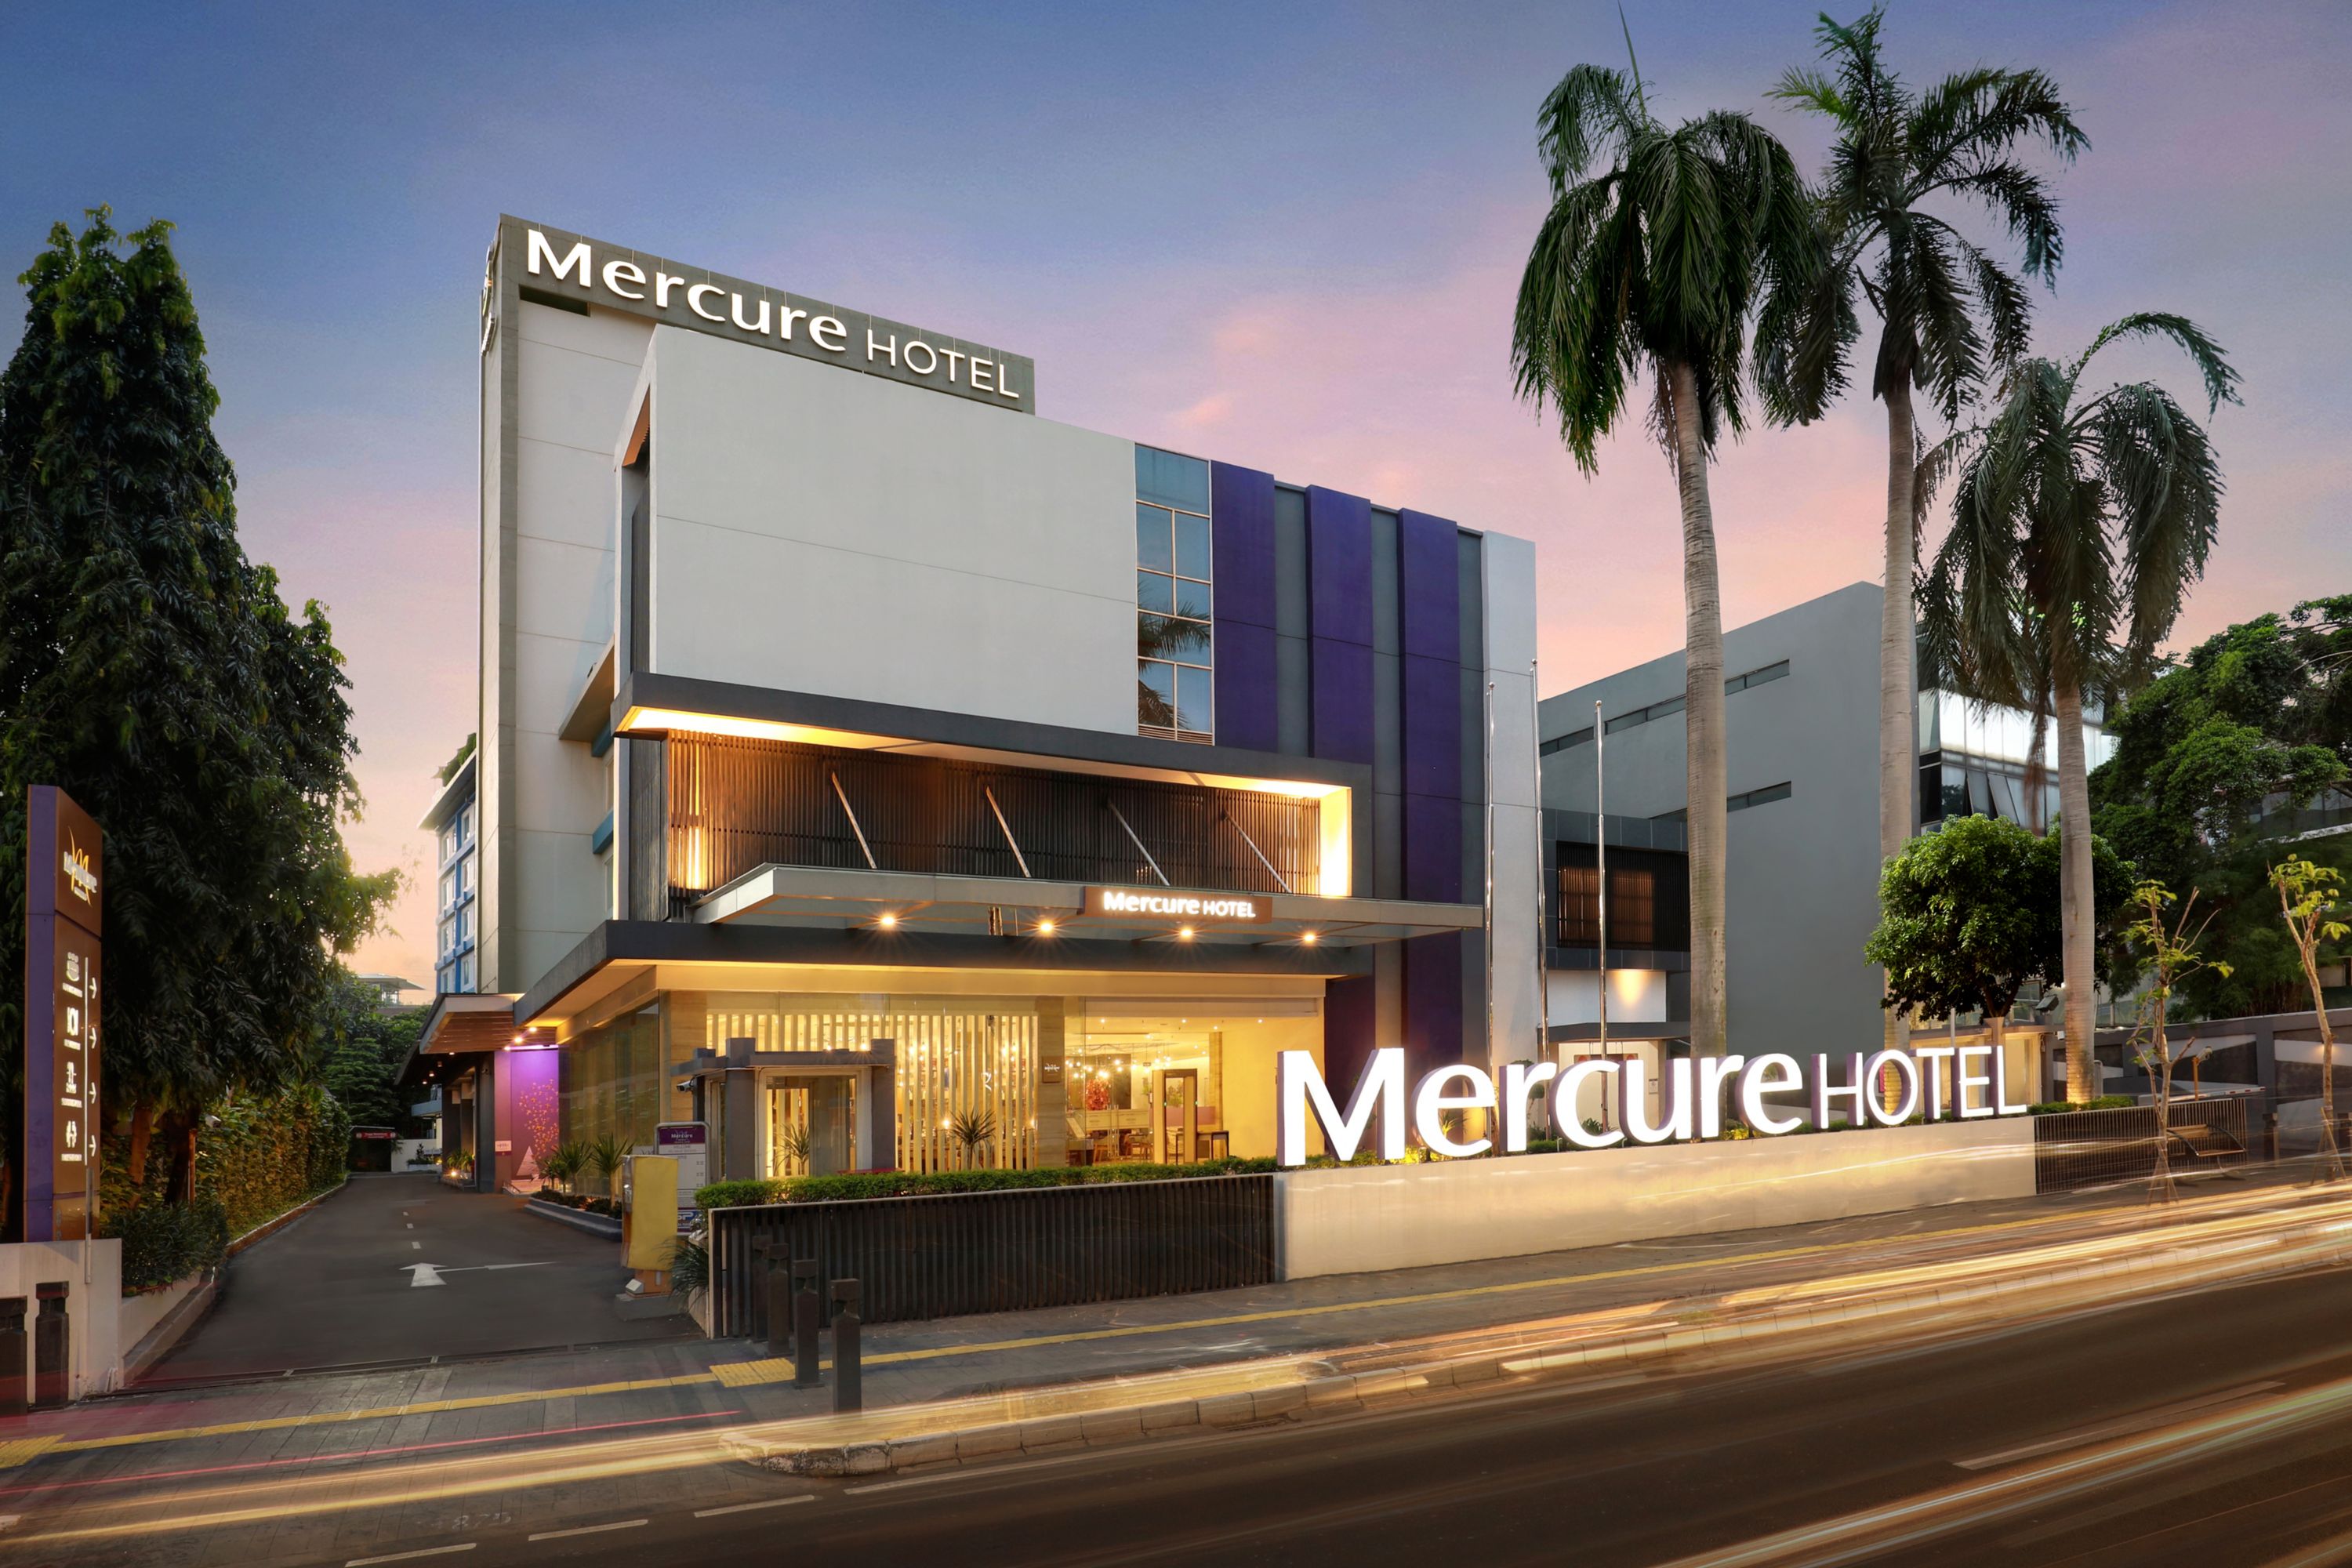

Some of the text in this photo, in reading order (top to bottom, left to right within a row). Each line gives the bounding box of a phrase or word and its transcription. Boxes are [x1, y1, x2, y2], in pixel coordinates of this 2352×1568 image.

[527, 228, 848, 352] Mercure
[866, 328, 1020, 399] HOTEL
[1103, 891, 1256, 918] Mercure HOTEL
[1279, 1045, 2027, 1167] Mercure HOTEL
